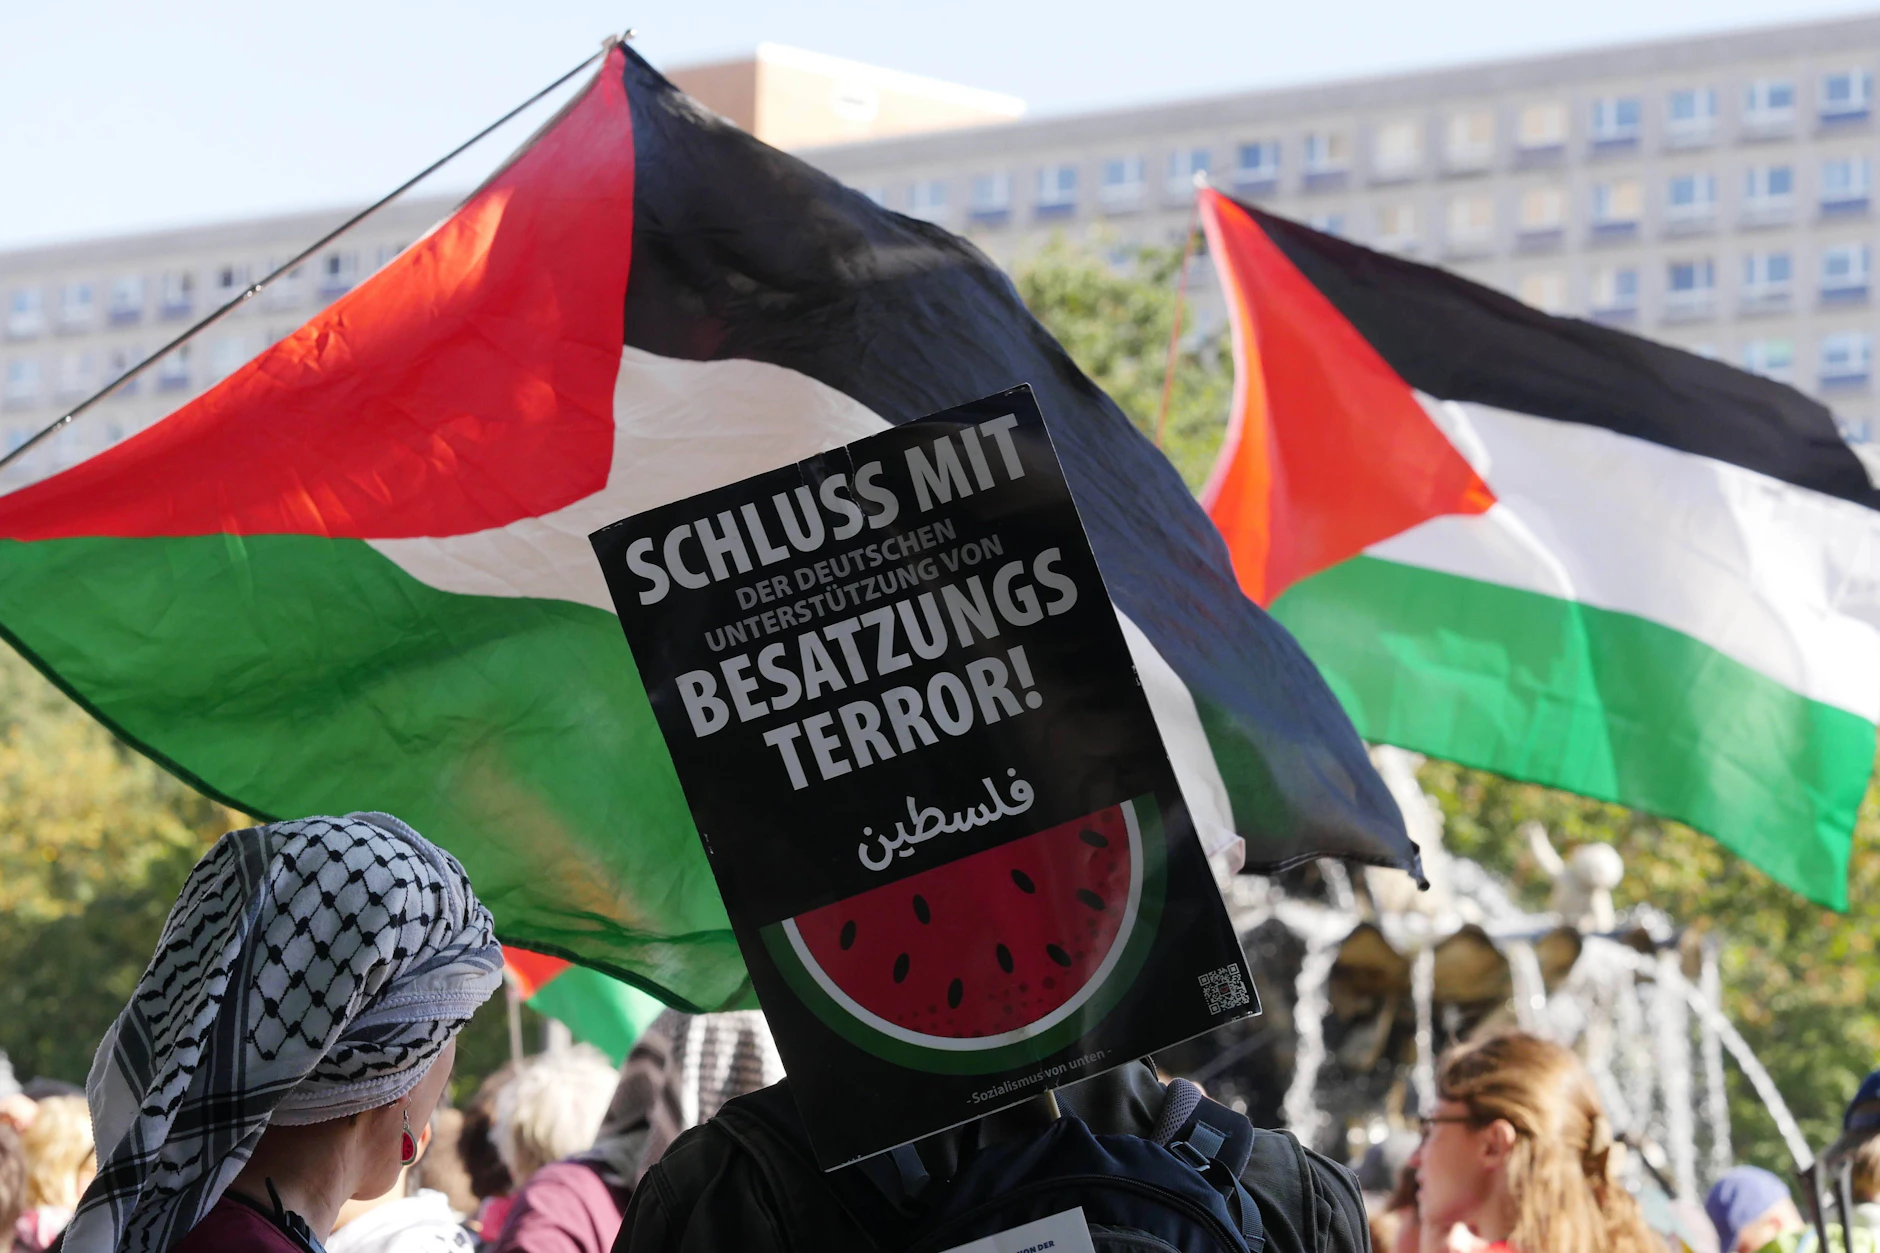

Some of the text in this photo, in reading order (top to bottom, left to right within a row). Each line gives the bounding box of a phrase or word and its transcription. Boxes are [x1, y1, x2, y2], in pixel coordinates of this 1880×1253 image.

[626, 412, 1026, 606] SCHLUSS MIT
[735, 517, 957, 611] DER DEUTSCHEN
[674, 547, 1078, 738] BESATZUNGS
[704, 533, 1004, 652] UNTERSTÜTZUNG VON
[763, 644, 1043, 791] TERROR!
[858, 767, 1035, 872] فلسطين
[1044, 1064, 1067, 1079] von
[1037, 1240, 1055, 1251] DER
